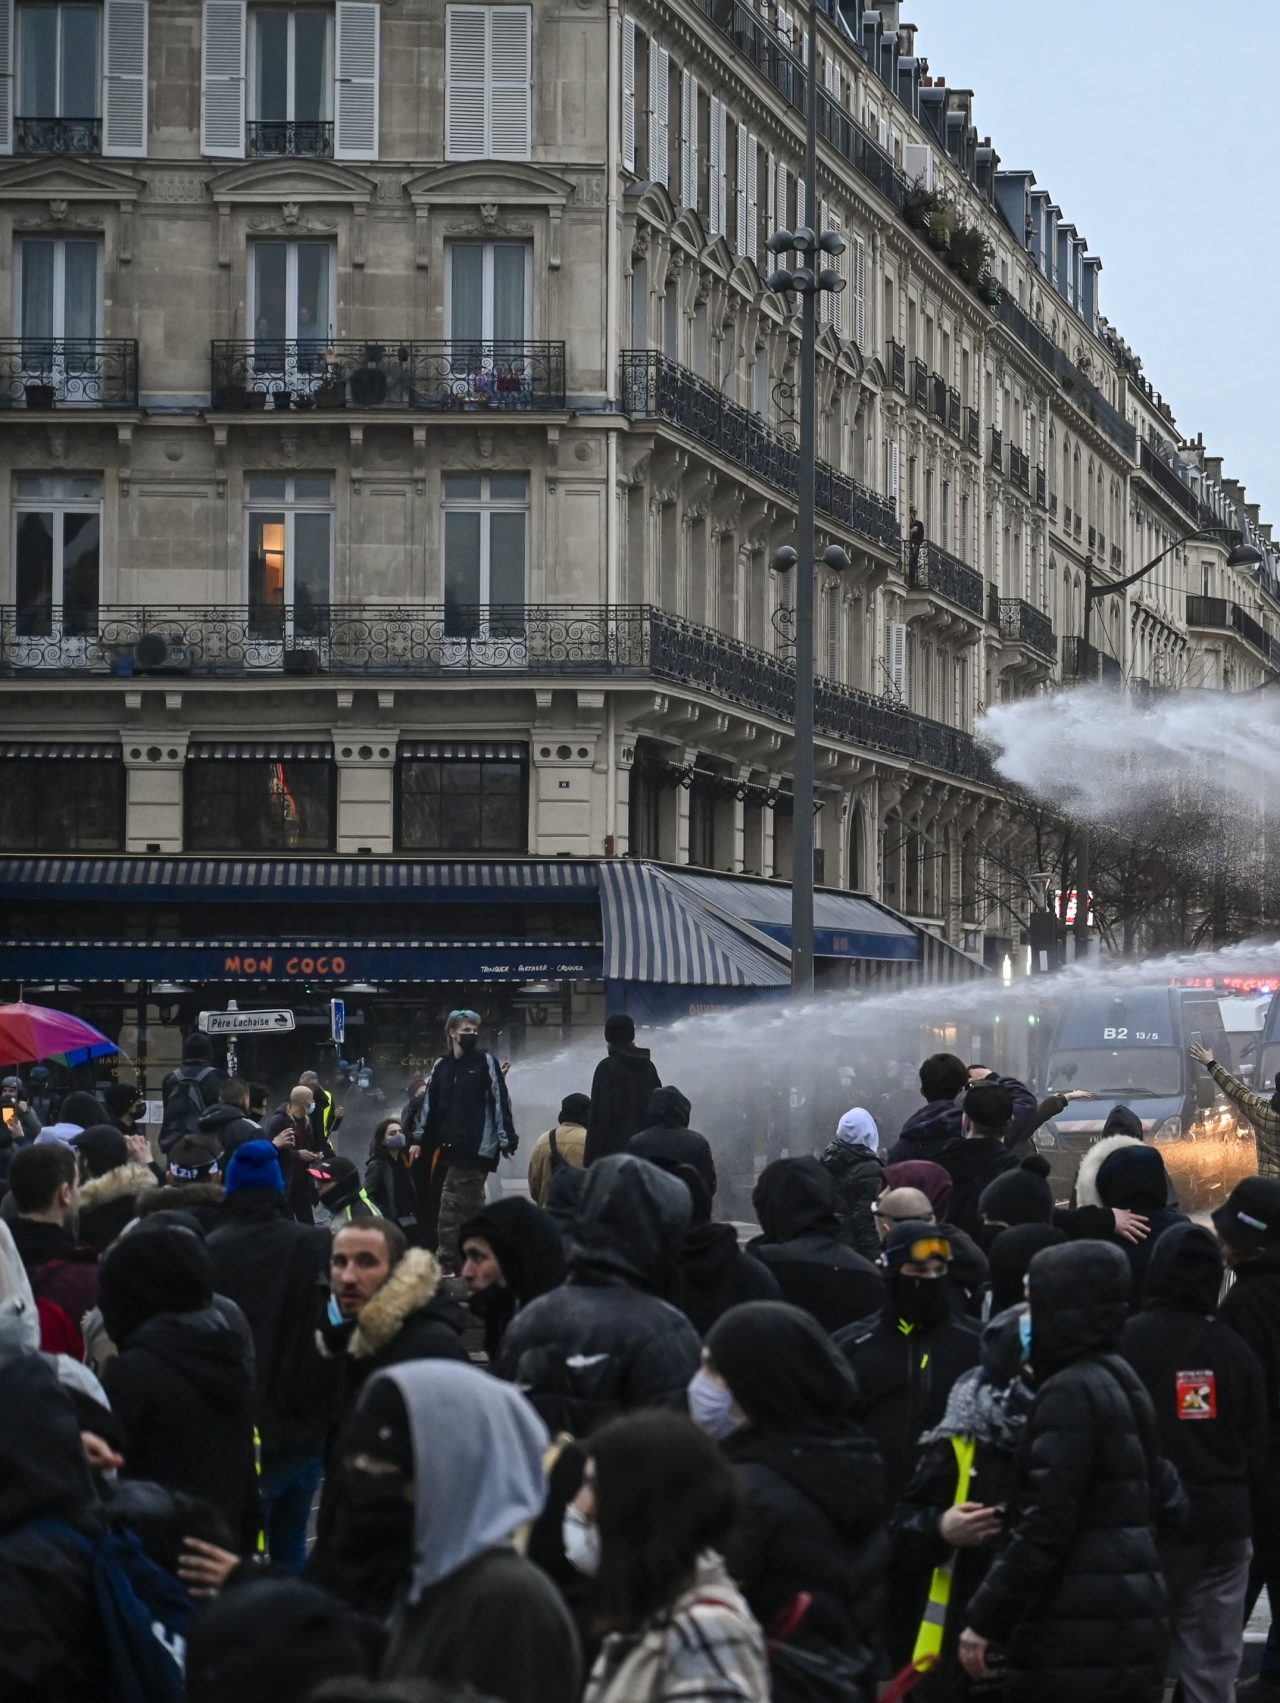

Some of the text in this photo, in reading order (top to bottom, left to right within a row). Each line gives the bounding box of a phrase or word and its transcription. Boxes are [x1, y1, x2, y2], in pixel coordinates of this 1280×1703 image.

[225, 955, 346, 975] MON COCO
[211, 1016, 270, 1028] Père Lachaise
[1103, 1027, 1159, 1040] B2 13/5
